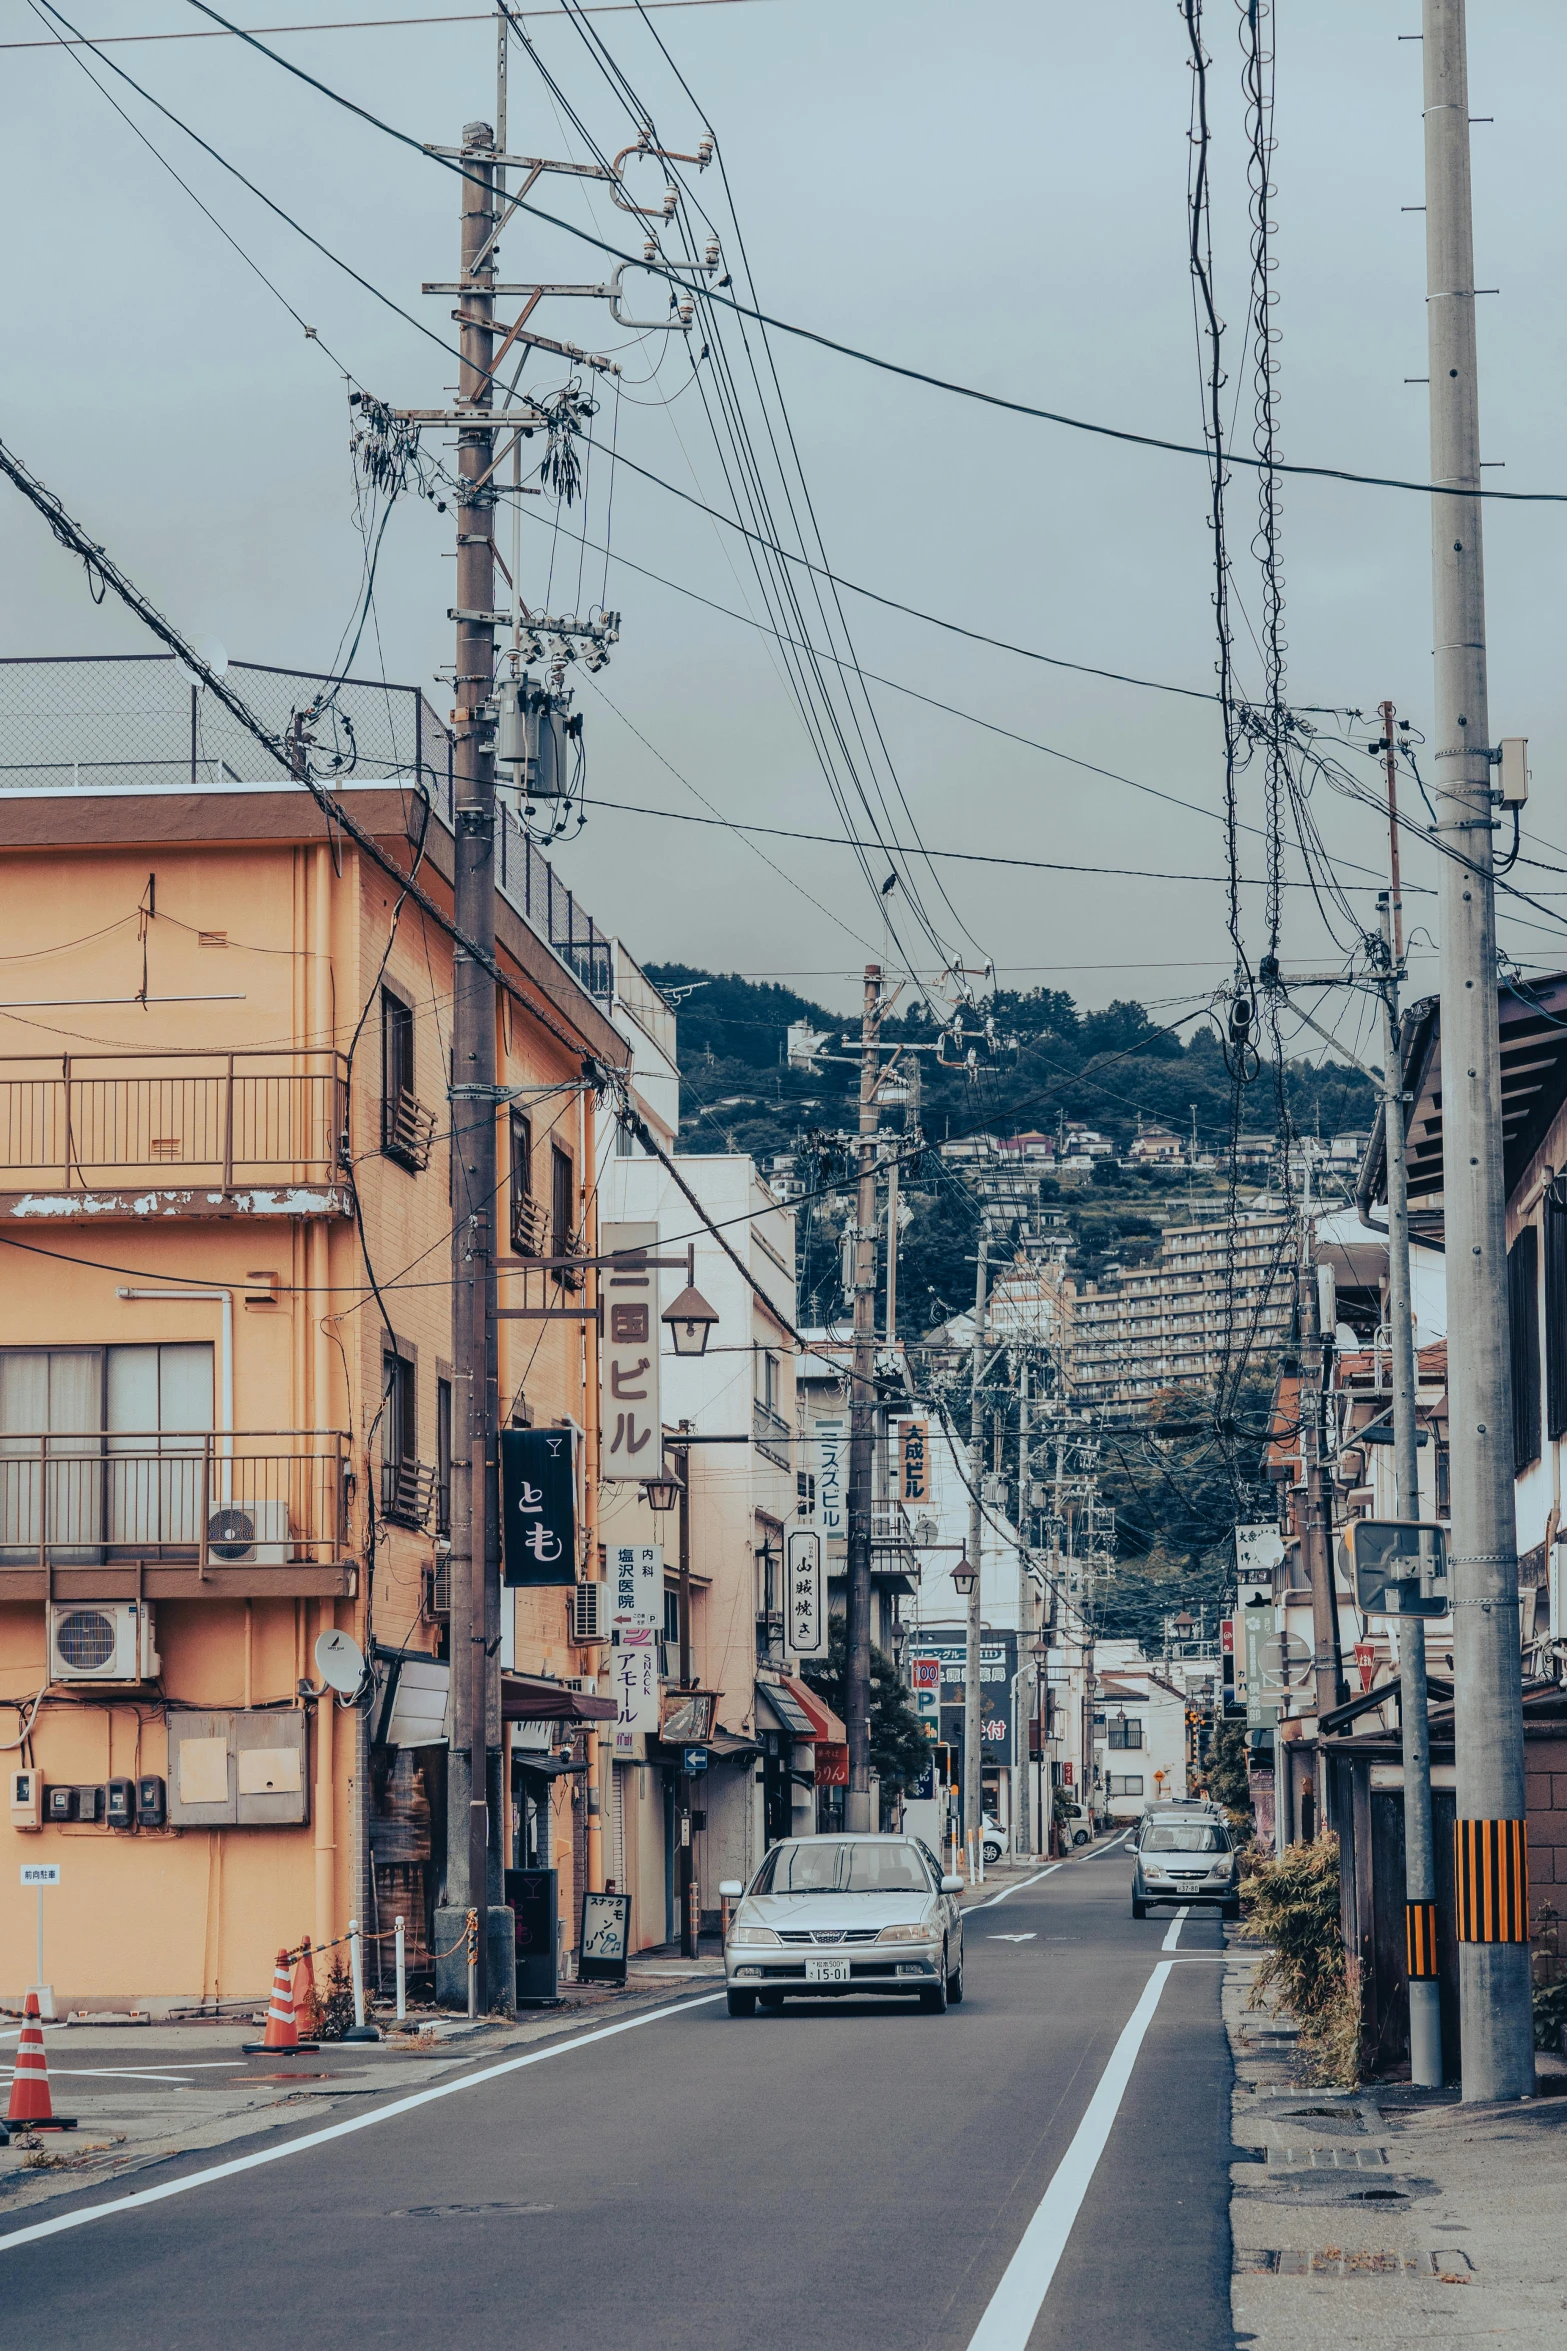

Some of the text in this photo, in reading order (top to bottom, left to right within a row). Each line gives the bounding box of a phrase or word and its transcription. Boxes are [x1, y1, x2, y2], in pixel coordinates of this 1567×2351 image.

[821, 1432, 840, 1528] ミスズビル
[904, 1424, 925, 1498] 大成ビル
[518, 1481, 563, 1562] とも
[617, 1548, 634, 1609] 塩沢医院
[641, 1548, 654, 1578] 内科
[795, 1556, 813, 1639] 山賊焼き
[616, 1653, 639, 1726] アモール
[643, 1653, 652, 1696] SNACK
[918, 1692, 936, 1713] P
[24, 1869, 56, 1880] 前向駐車
[590, 1897, 624, 1908] スナック
[817, 1968, 847, 1981] 15-01
